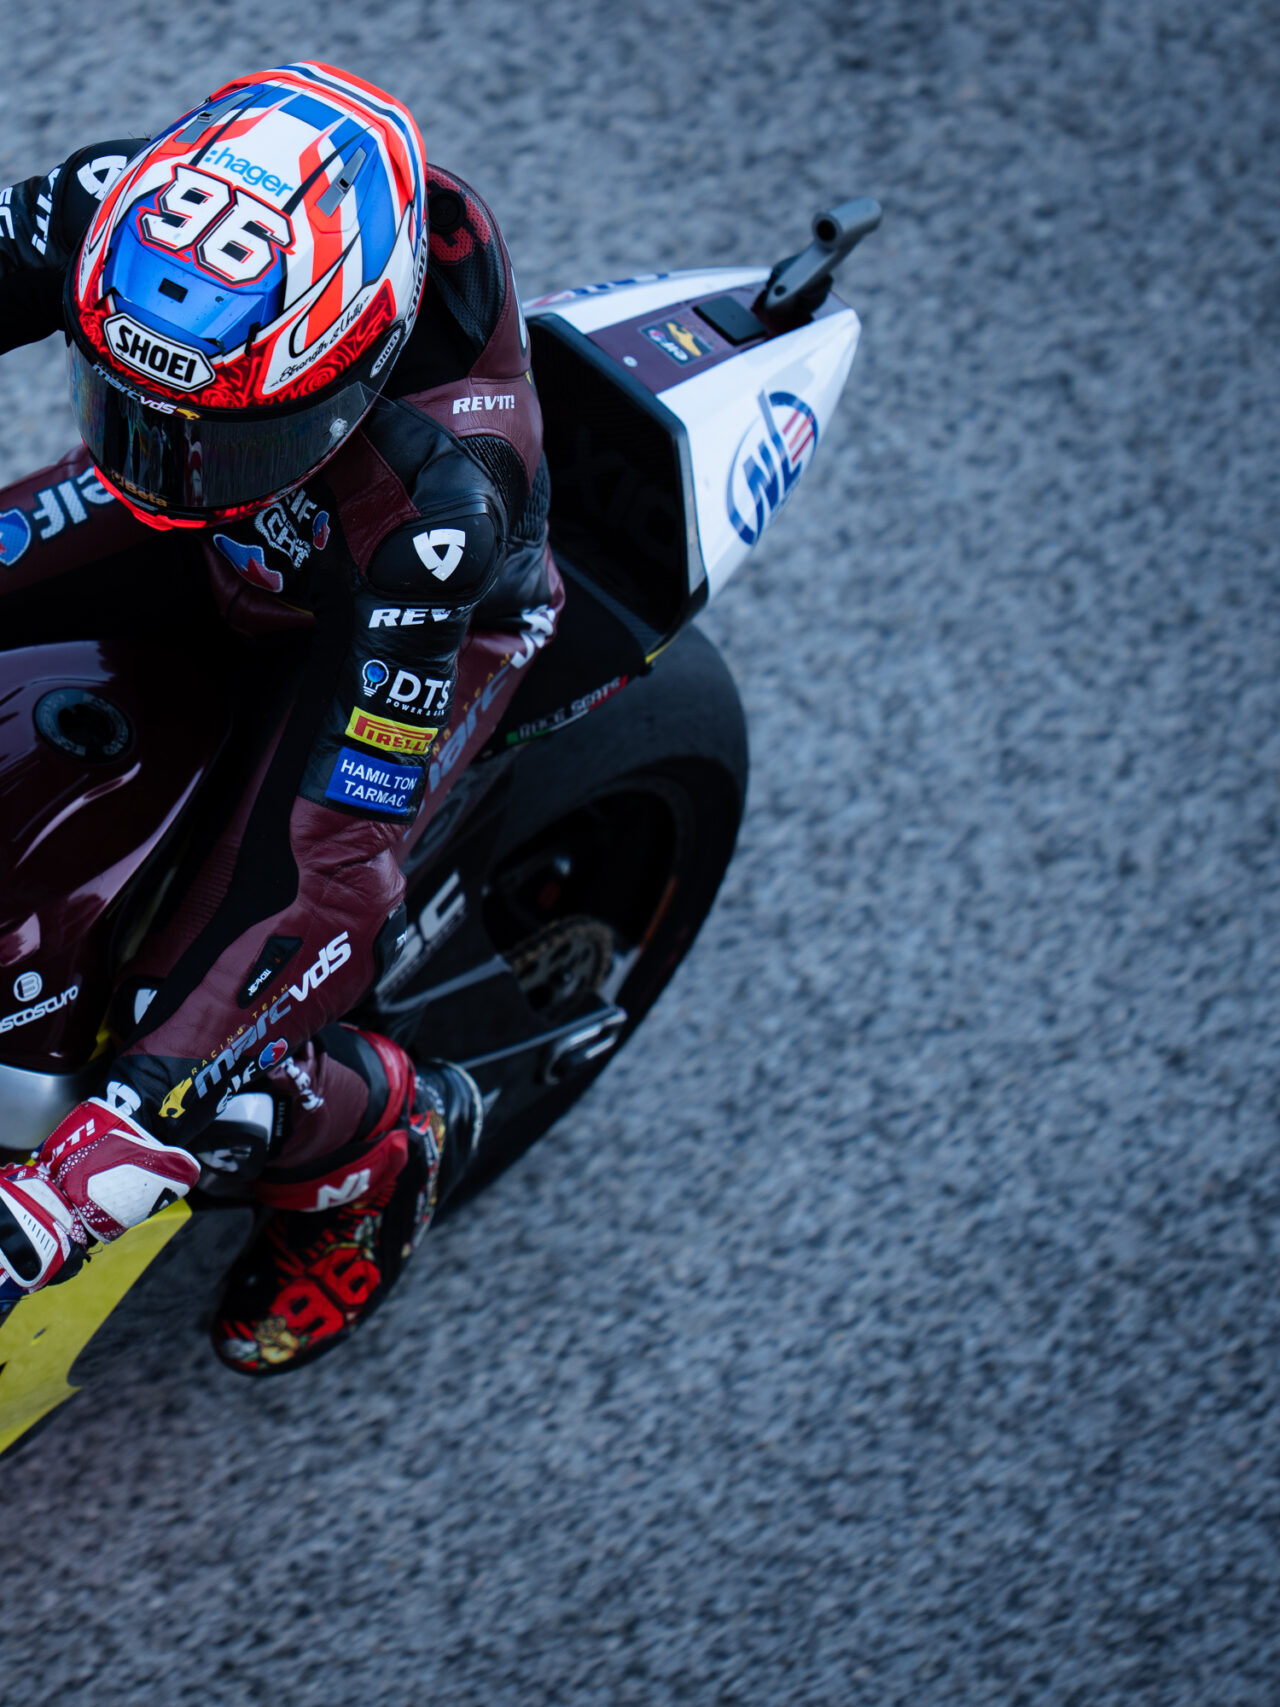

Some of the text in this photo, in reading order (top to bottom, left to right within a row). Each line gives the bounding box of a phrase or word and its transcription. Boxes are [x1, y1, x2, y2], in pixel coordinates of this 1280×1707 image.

[139, 164, 295, 287] 96
[116, 325, 197, 384] SHOEI
[389, 670, 451, 711] DTS
[354, 714, 434, 752] PIRELLI
[340, 759, 418, 791] HAMILTON
[344, 780, 406, 808] TARMAC
